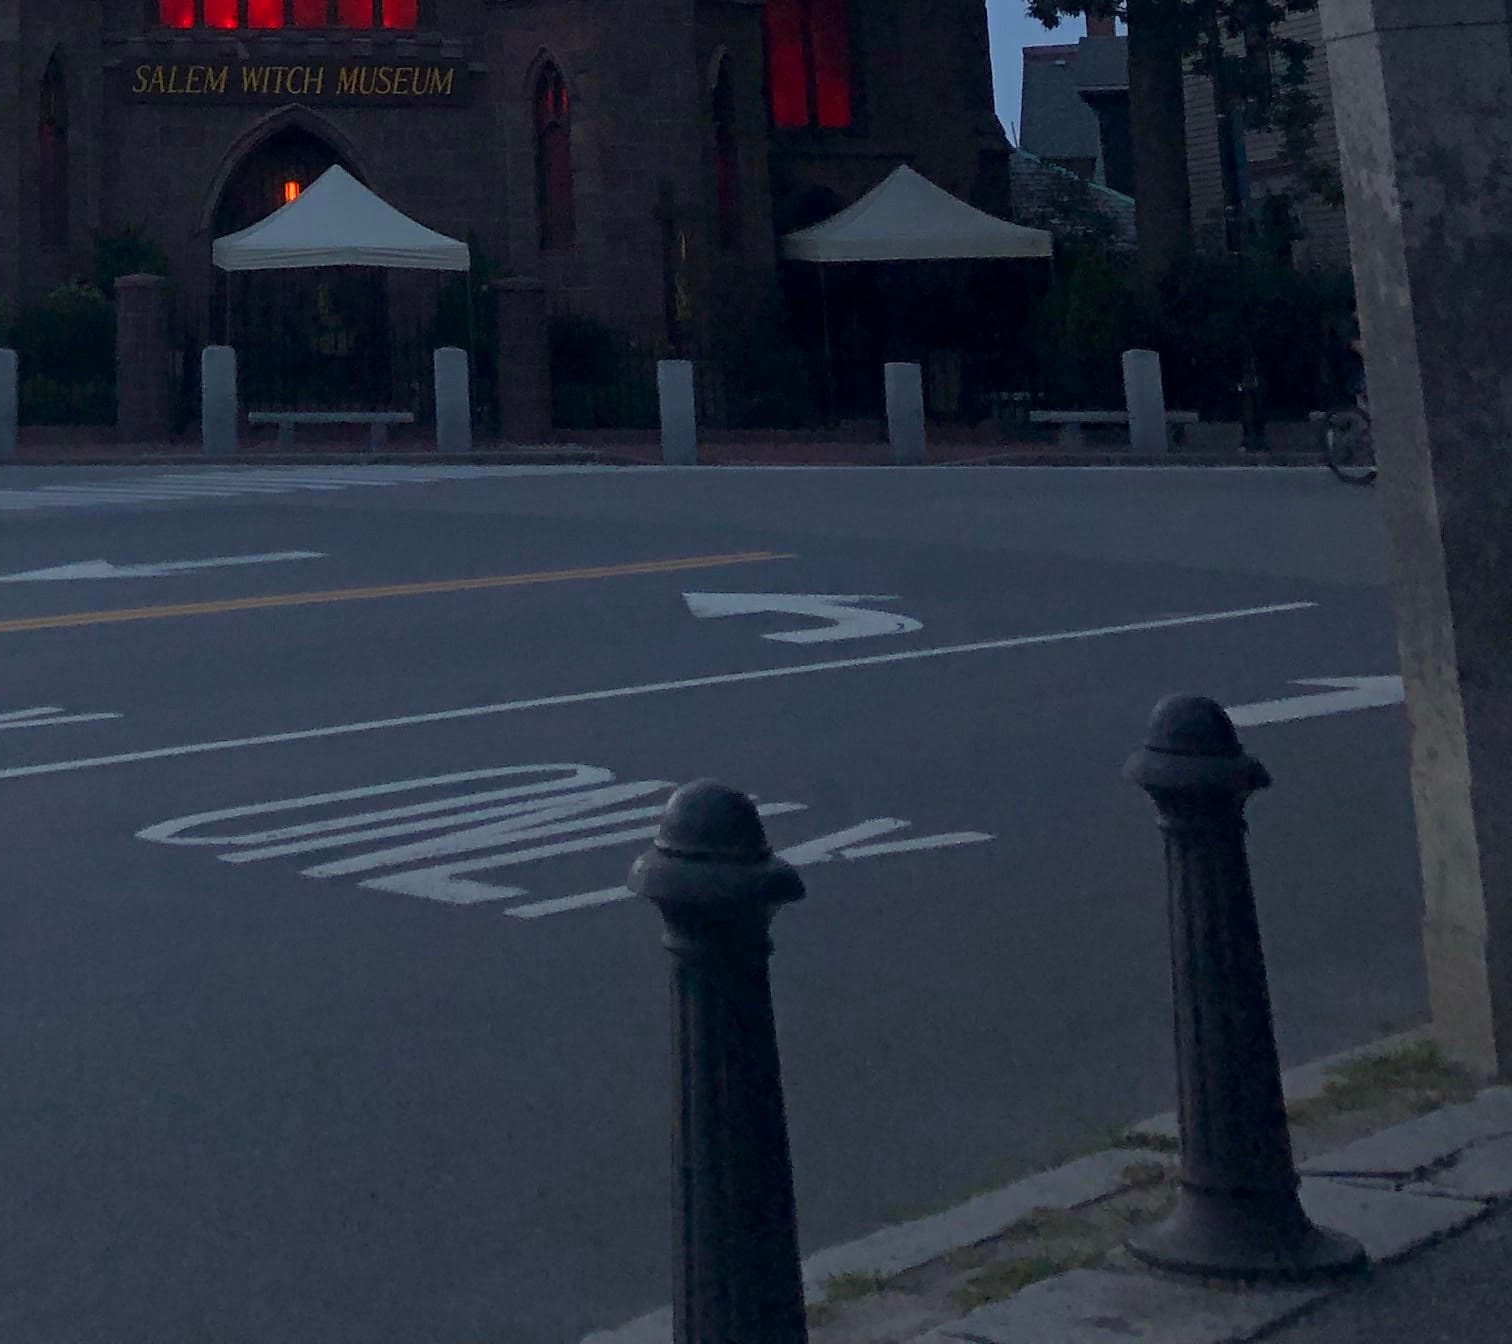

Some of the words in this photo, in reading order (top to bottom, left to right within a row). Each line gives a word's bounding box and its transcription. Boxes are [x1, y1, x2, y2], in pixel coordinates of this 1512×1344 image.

[132, 64, 230, 94] SALEM
[241, 65, 324, 94] WITCH
[336, 65, 455, 96] MUSEUM
